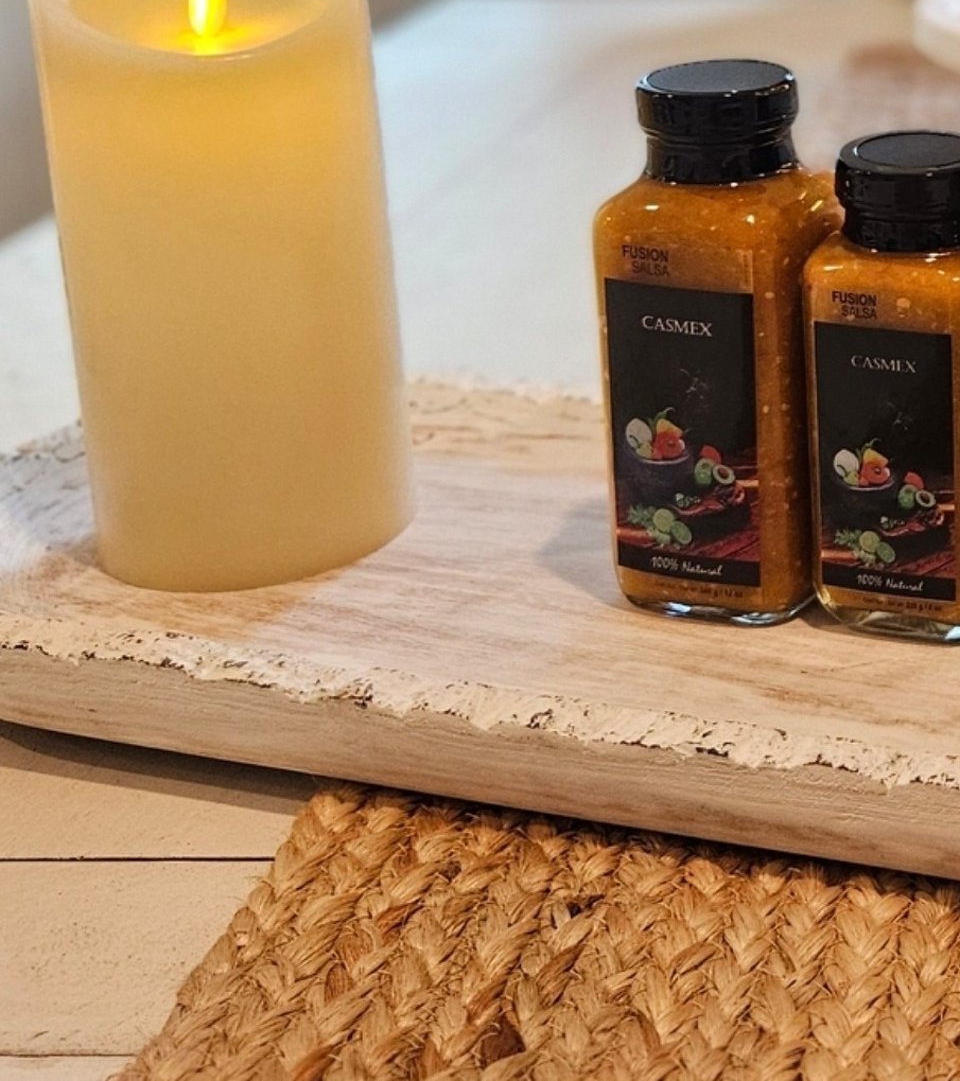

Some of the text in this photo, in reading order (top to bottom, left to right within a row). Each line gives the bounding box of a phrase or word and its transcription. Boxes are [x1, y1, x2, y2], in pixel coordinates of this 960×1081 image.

[621, 245, 669, 263] FUSION
[632, 260, 671, 277] SALSA
[831, 291, 877, 307] FUSION
[841, 305, 878, 320] SALSA
[641, 315, 713, 337] CASMEX
[850, 355, 917, 374] CASMEX
[650, 556, 723, 576] 100% Natural
[857, 574, 924, 592] 100% Natural
